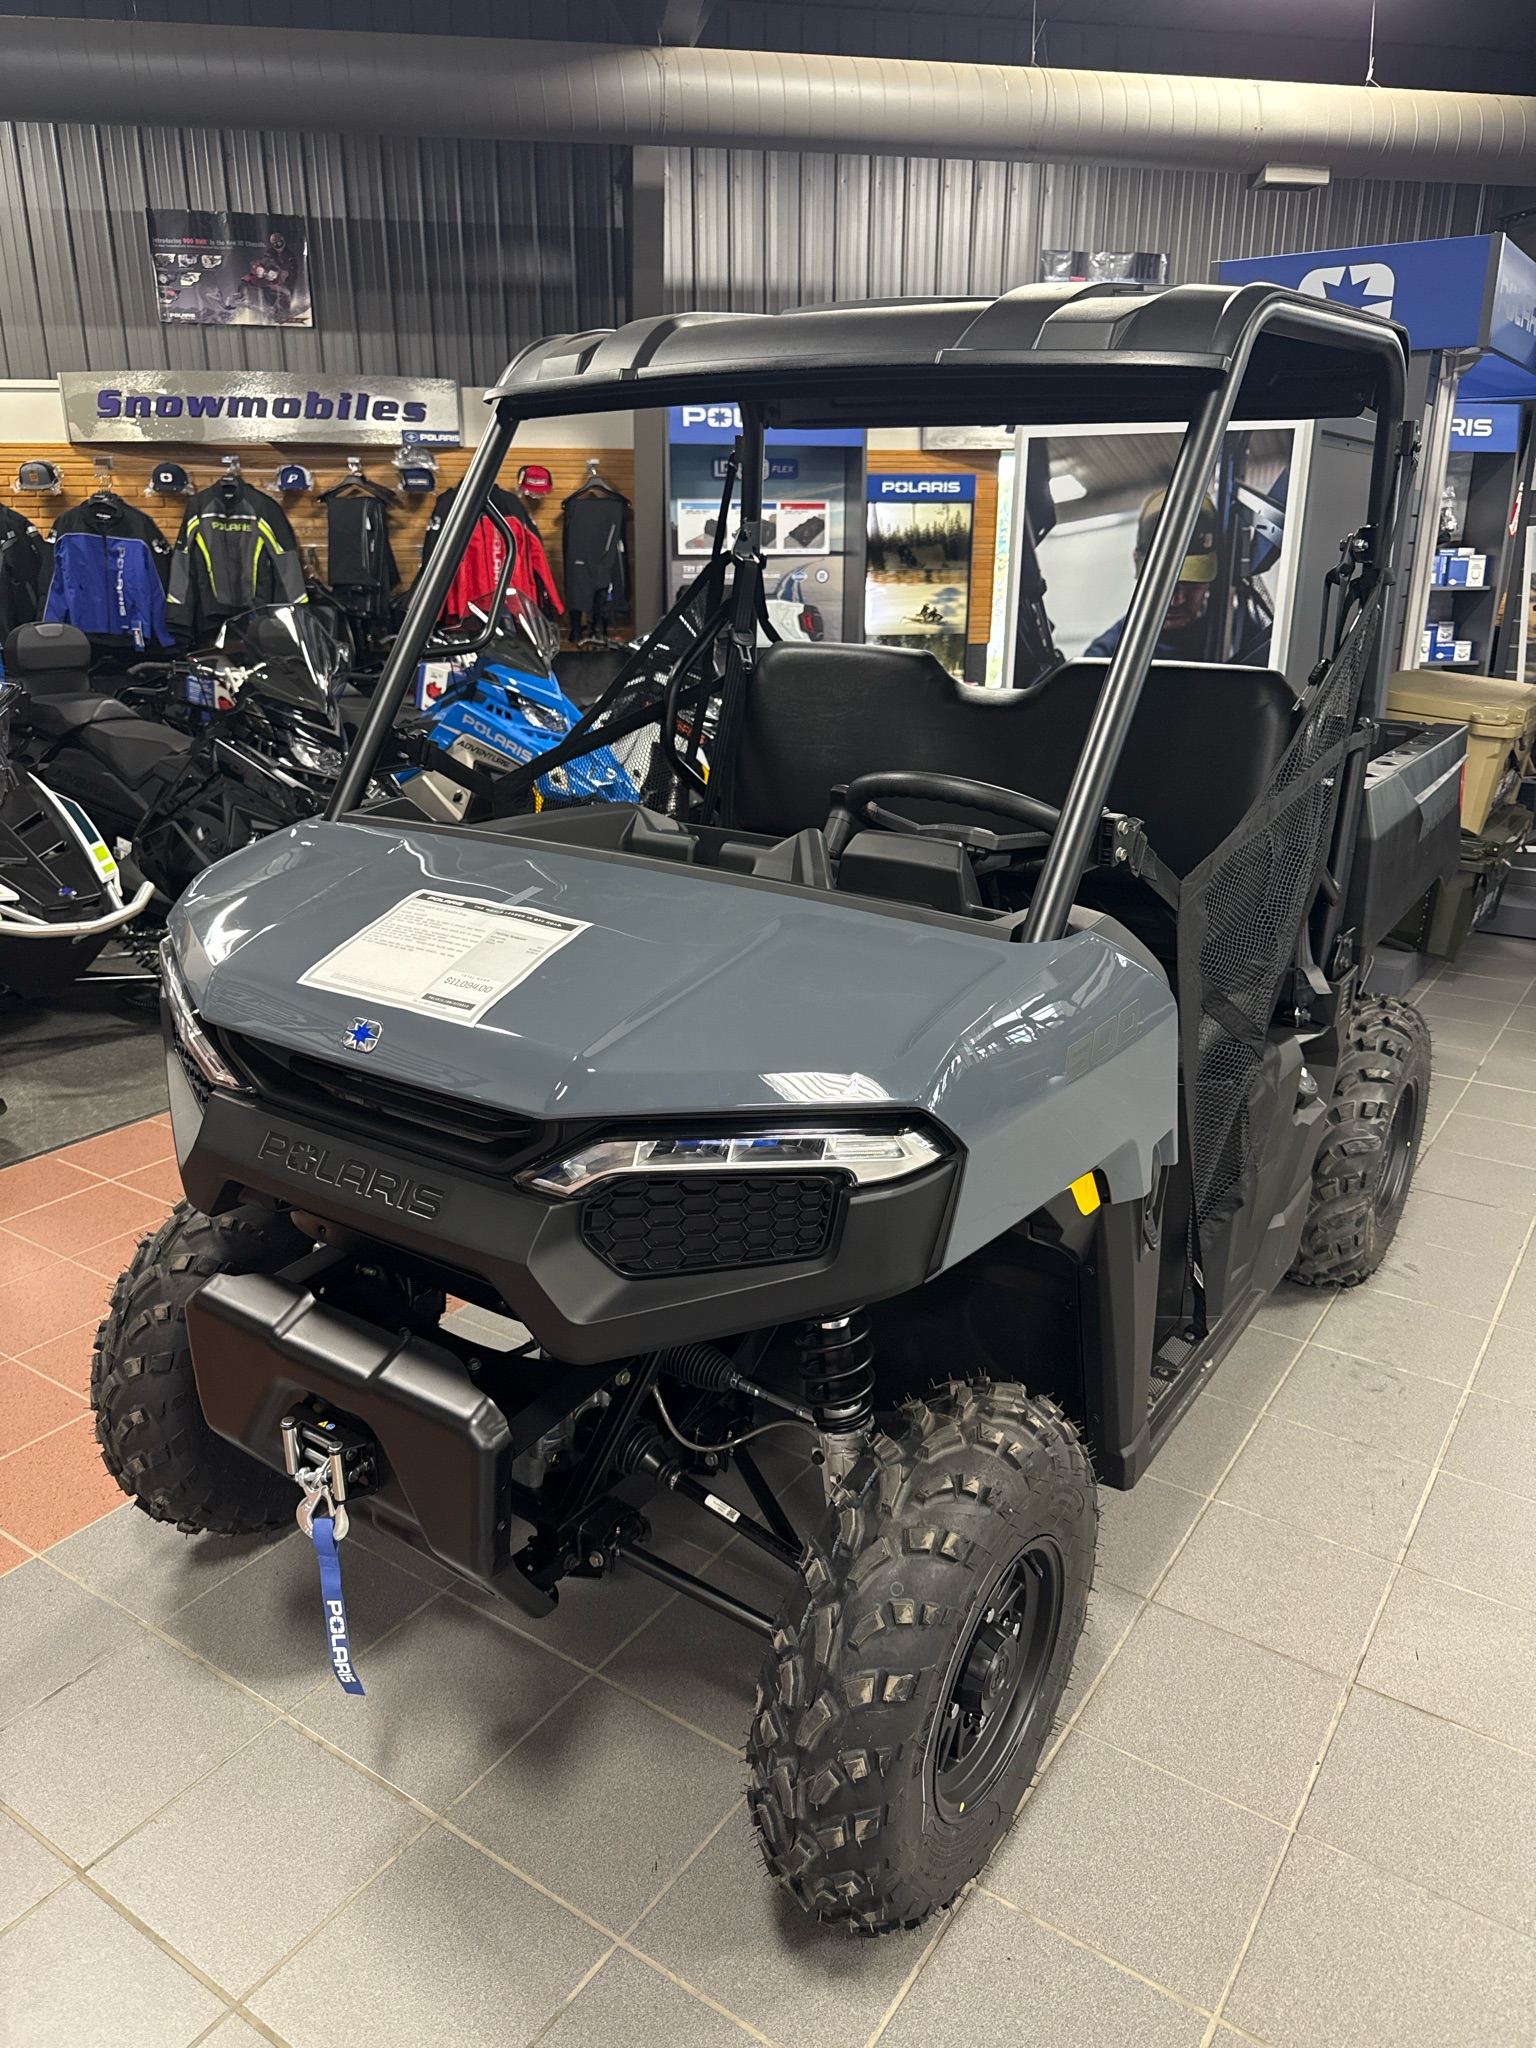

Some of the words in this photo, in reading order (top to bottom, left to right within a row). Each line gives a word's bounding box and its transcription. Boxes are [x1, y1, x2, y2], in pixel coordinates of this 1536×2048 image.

[97, 389, 427, 424] Snowmobiles
[419, 432, 460, 443] POLARIS
[771, 464, 794, 473] FLEX
[881, 481, 961, 494] POLARIS
[211, 521, 252, 532] POLARIS
[116, 546, 126, 616] POLARIS
[462, 713, 533, 763] POLARIS
[457, 740, 511, 768] ADVENTURE
[426, 895, 466, 906] POLARIS
[443, 976, 494, 993] $11,094.00
[1064, 998, 1140, 1086] 500
[257, 1130, 446, 1221] POLARIS
[326, 1600, 357, 1683] POLARIS
